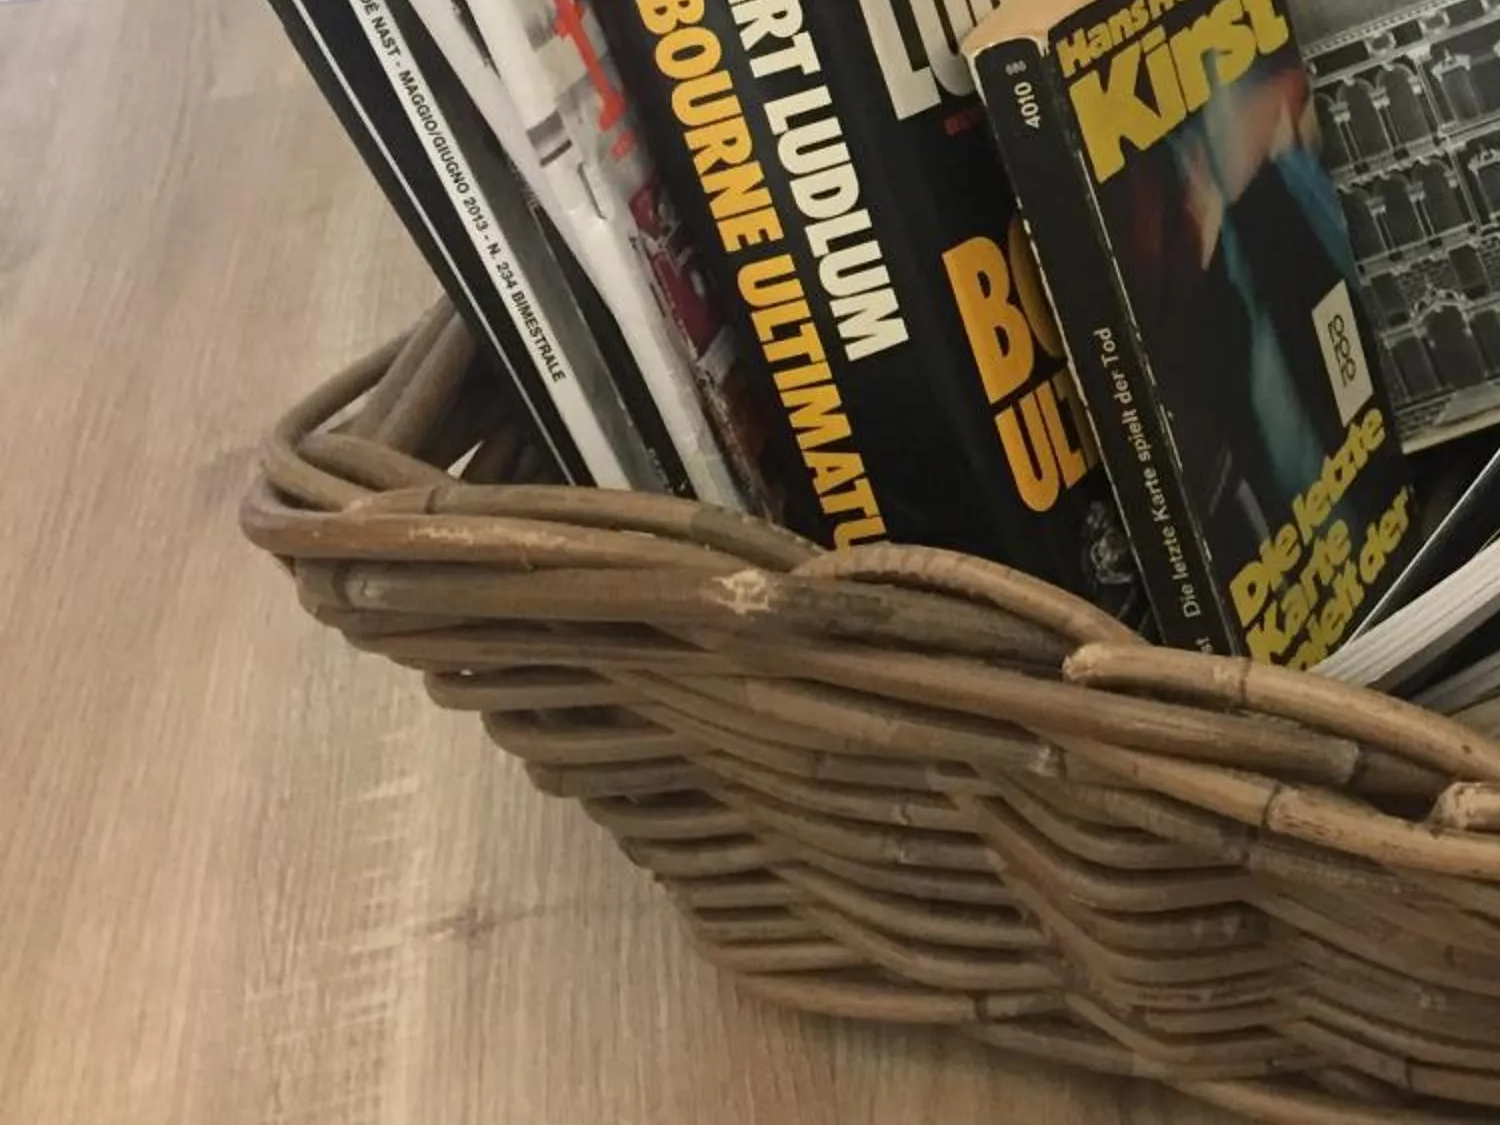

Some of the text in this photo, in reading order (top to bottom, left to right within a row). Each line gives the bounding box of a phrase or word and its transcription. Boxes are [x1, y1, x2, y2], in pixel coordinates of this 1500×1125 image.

[371, 13, 401, 57] NAST
[399, 69, 469, 196] MAGGIO/GIUGNO
[463, 196, 489, 232] 2013
[497, 261, 516, 291] 234
[511, 289, 568, 383] BIMESTRALE
[1014, 81, 1040, 129] 4010
[763, 85, 909, 362] LUDLUM
[1094, 328, 1201, 618] Die letzte Karte spielt der Tod
[1359, 485, 1410, 584] der
[1229, 523, 1301, 627] Die
